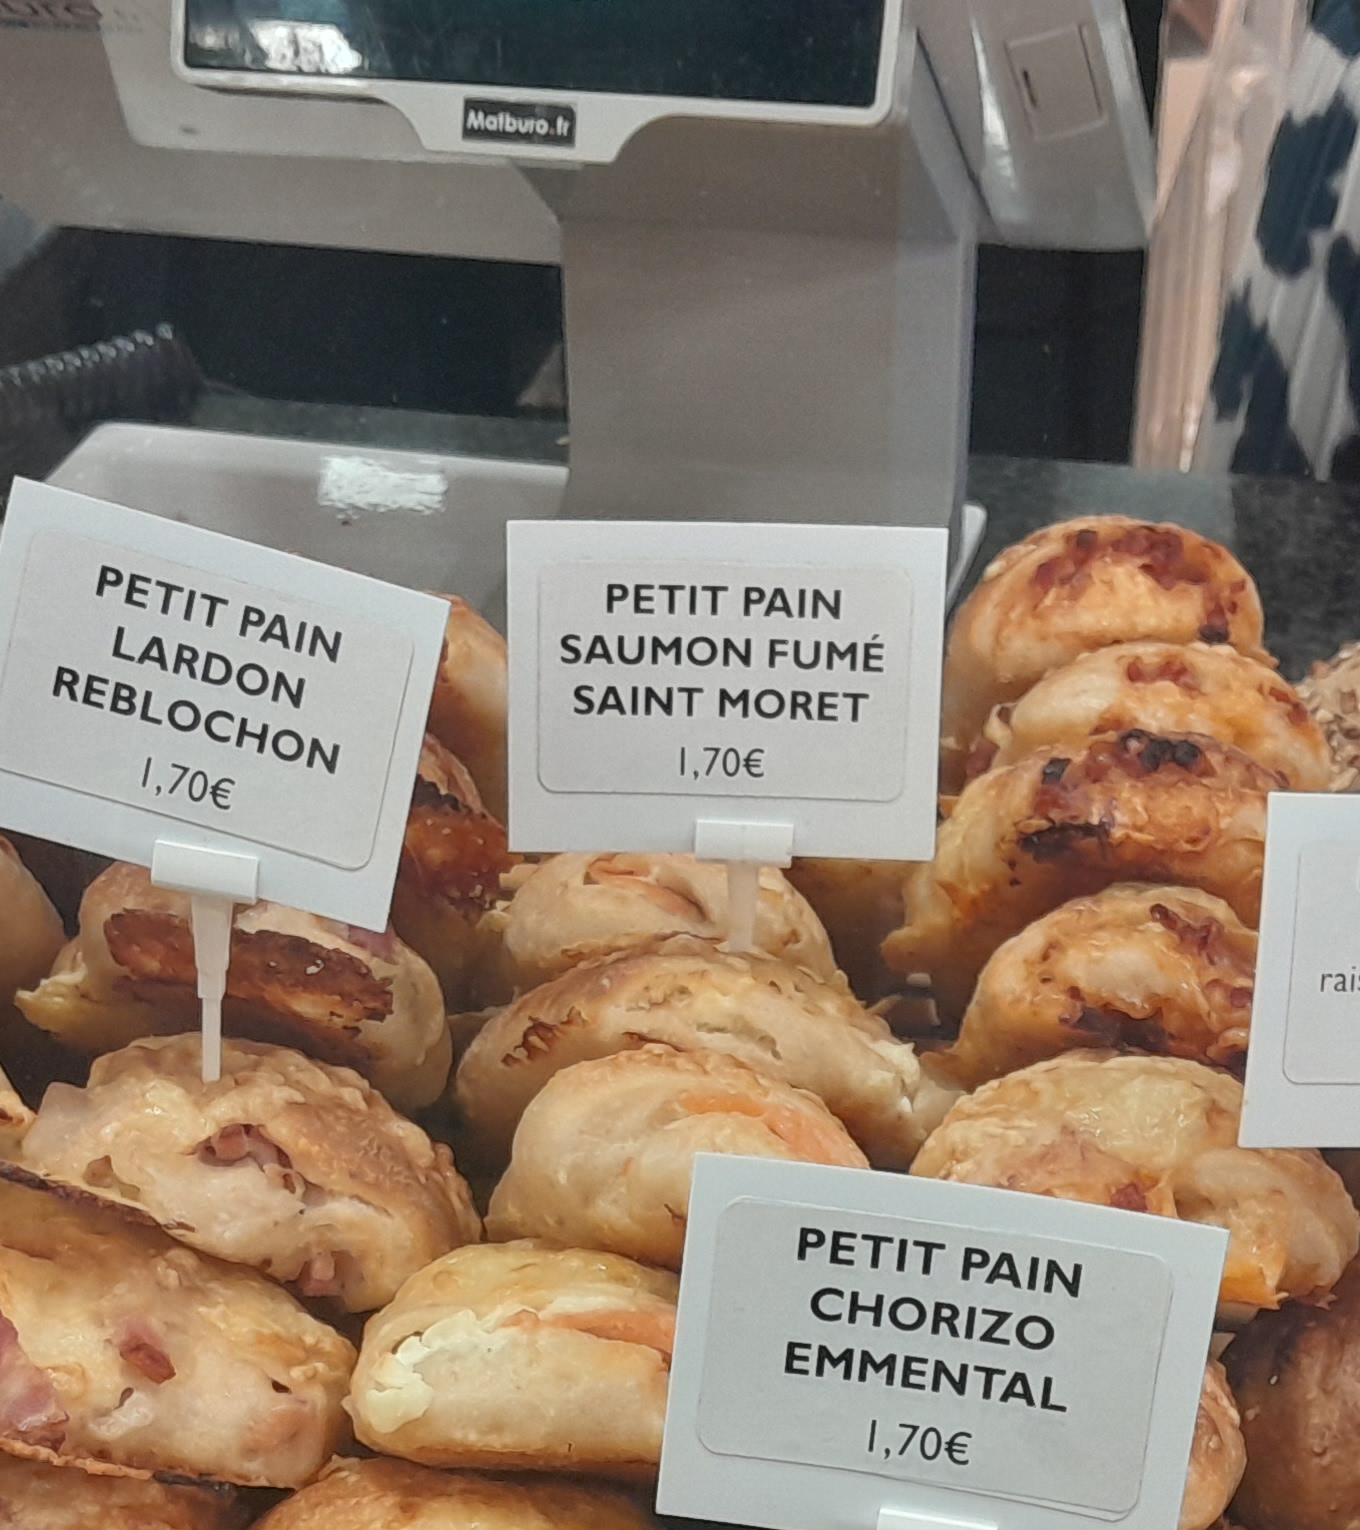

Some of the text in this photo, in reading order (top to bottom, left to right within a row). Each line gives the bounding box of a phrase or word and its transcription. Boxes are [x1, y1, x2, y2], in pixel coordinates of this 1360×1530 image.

[95, 564, 343, 664] PETIT PAIN
[606, 583, 842, 620] PETIT PAIN
[111, 625, 306, 709] LARDON
[560, 633, 885, 673] SAUMON FUMÉ
[52, 665, 341, 775] REBLOCHON
[573, 684, 870, 723] SAINT MORET
[141, 756, 236, 811] 1,70€
[680, 746, 765, 781] 1,70€
[797, 1226, 1083, 1298] PETIT PAIN
[810, 1287, 1055, 1351] CHORIZO
[784, 1341, 1068, 1413] EMMENTAL
[867, 1419, 973, 1466] 1,70€
